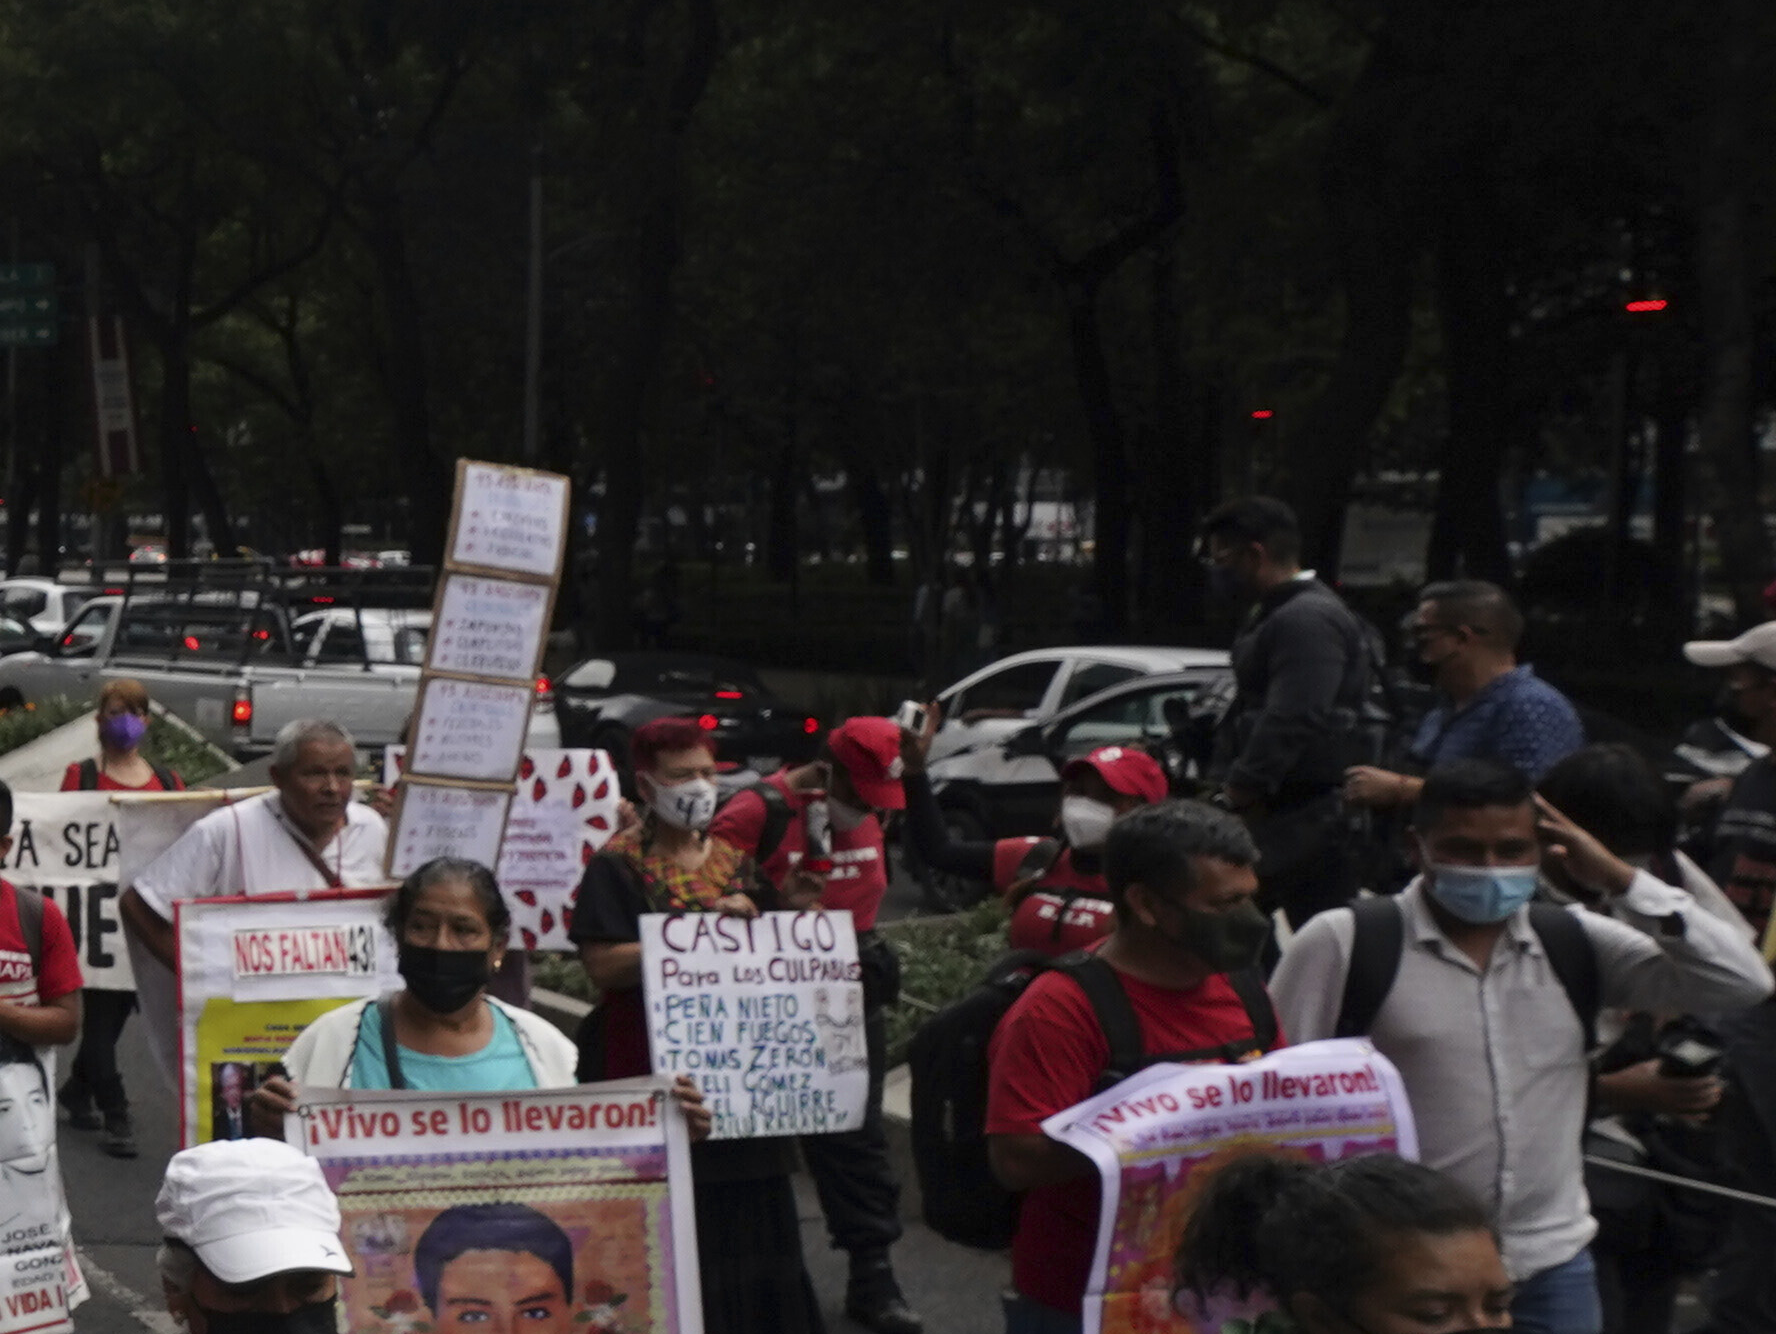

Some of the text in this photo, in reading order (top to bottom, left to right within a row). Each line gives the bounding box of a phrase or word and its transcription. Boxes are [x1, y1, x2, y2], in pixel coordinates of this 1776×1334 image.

[64, 821, 120, 868] SEA
[235, 933, 274, 973] NOS
[279, 931, 348, 972] FALTAN
[661, 913, 836, 954] CASTIGO
[661, 957, 720, 989] Para
[665, 994, 798, 1019] PEÑA NIETO
[665, 1020, 724, 1045] CIEN
[1091, 1089, 1179, 1135] ¡Vivo
[1186, 1084, 1223, 1109] se
[1229, 1076, 1253, 1105] lo
[1261, 1063, 1380, 1101] llevaron!
[308, 1095, 659, 1145] ¡Vivo se lo llevaron!
[6, 1293, 54, 1318] VIDA
